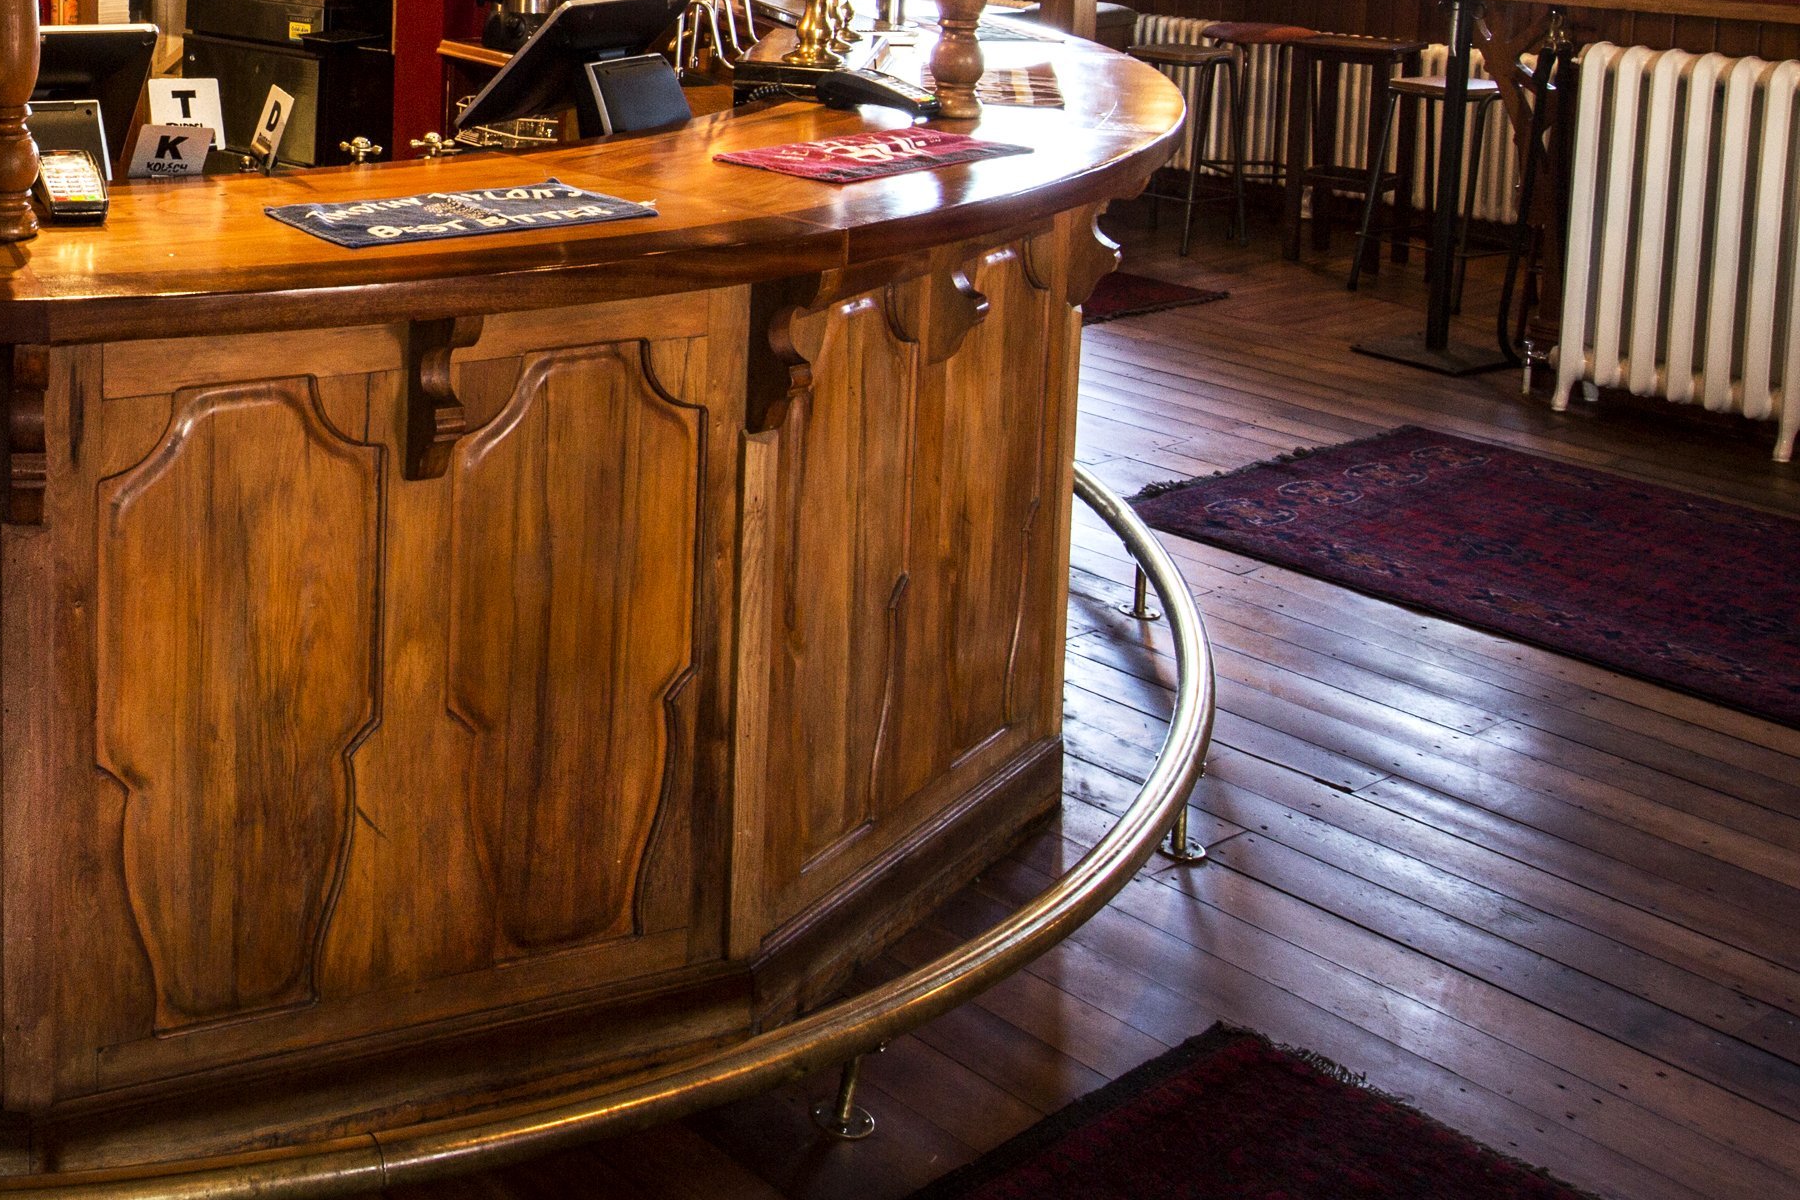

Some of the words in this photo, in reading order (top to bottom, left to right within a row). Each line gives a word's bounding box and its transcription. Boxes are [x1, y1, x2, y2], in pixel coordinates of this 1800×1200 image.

[171, 89, 197, 119] T
[265, 99, 282, 133] D
[154, 135, 190, 160] K
[304, 196, 424, 225] TIMOTHY
[366, 219, 470, 239] BEST
[477, 203, 615, 229] BITTER
